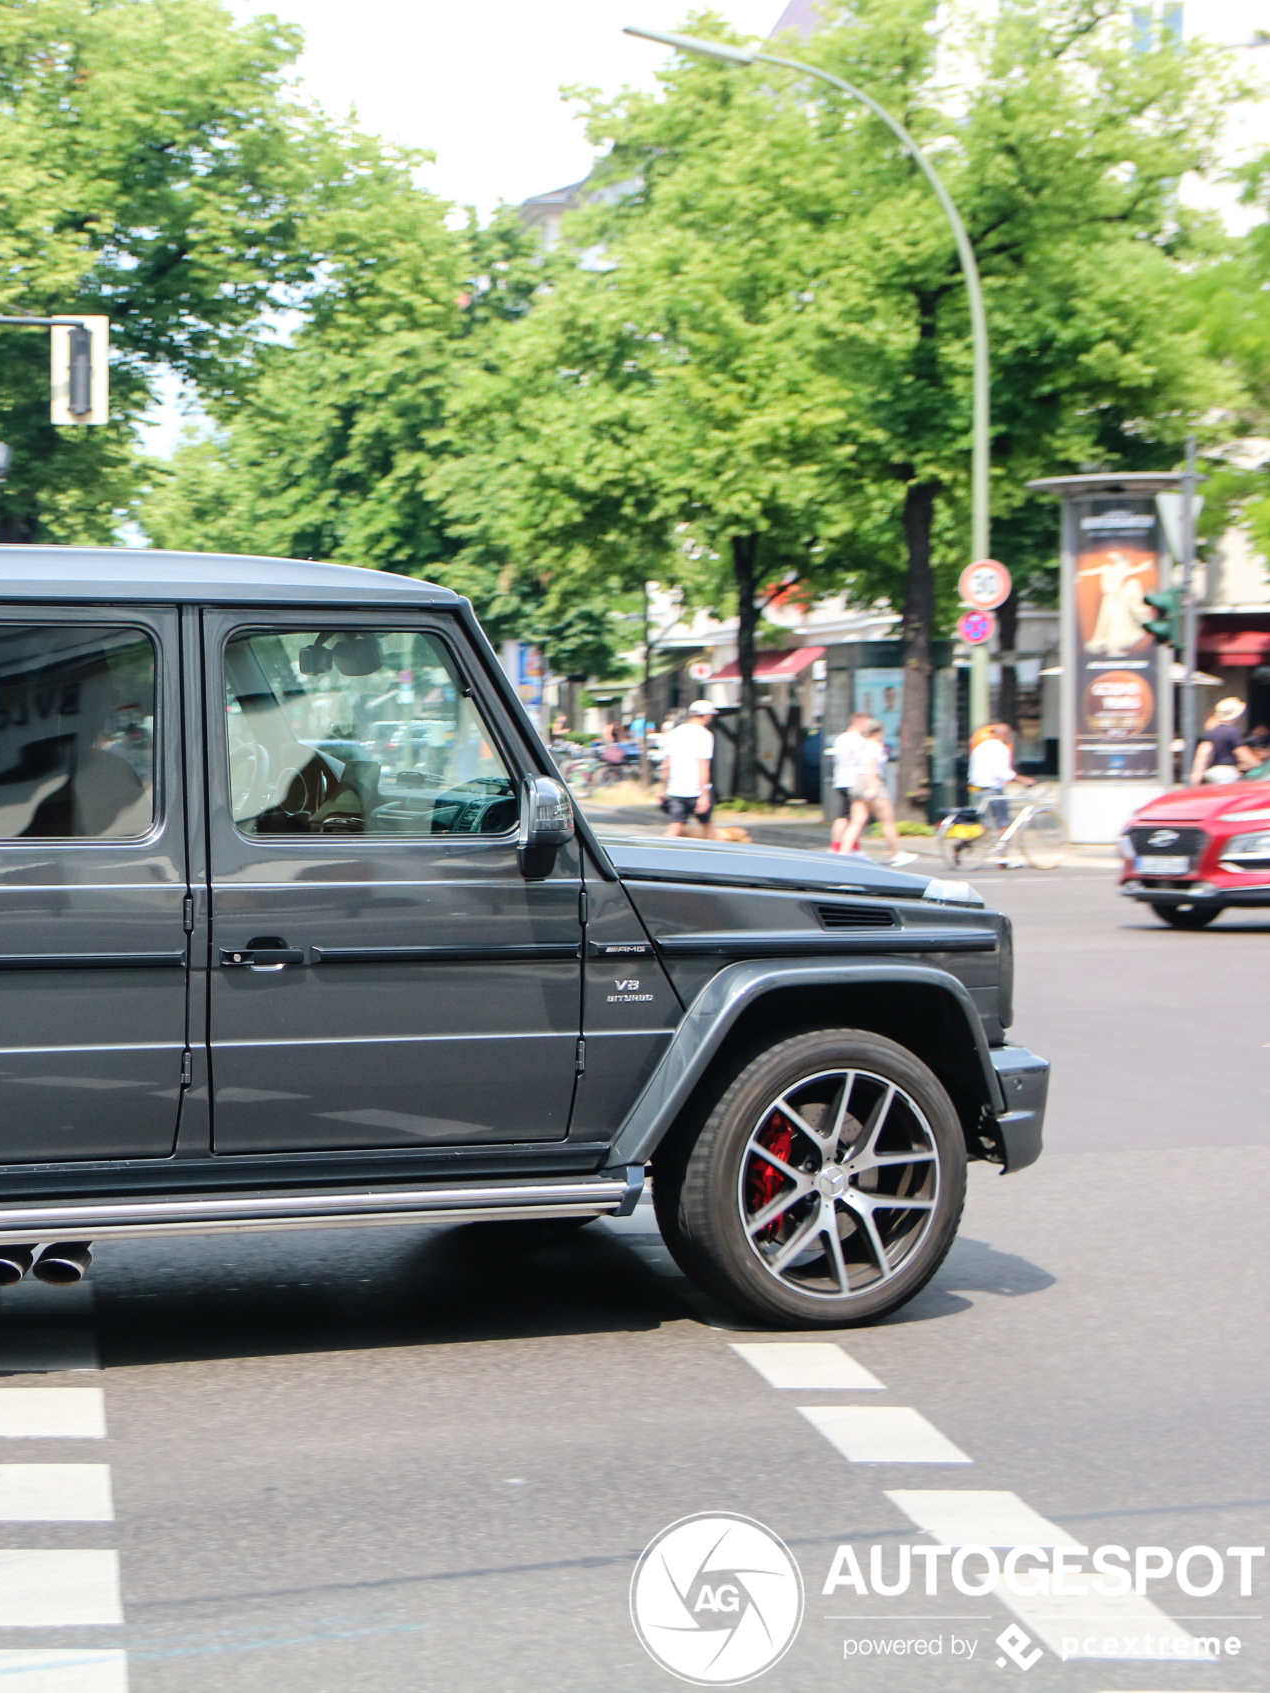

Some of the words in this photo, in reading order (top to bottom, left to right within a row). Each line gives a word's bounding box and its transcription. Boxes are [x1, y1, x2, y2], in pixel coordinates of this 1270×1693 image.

[617, 945, 646, 953] AMG
[614, 979, 640, 991] V8
[606, 994, 654, 1003] BITURBO
